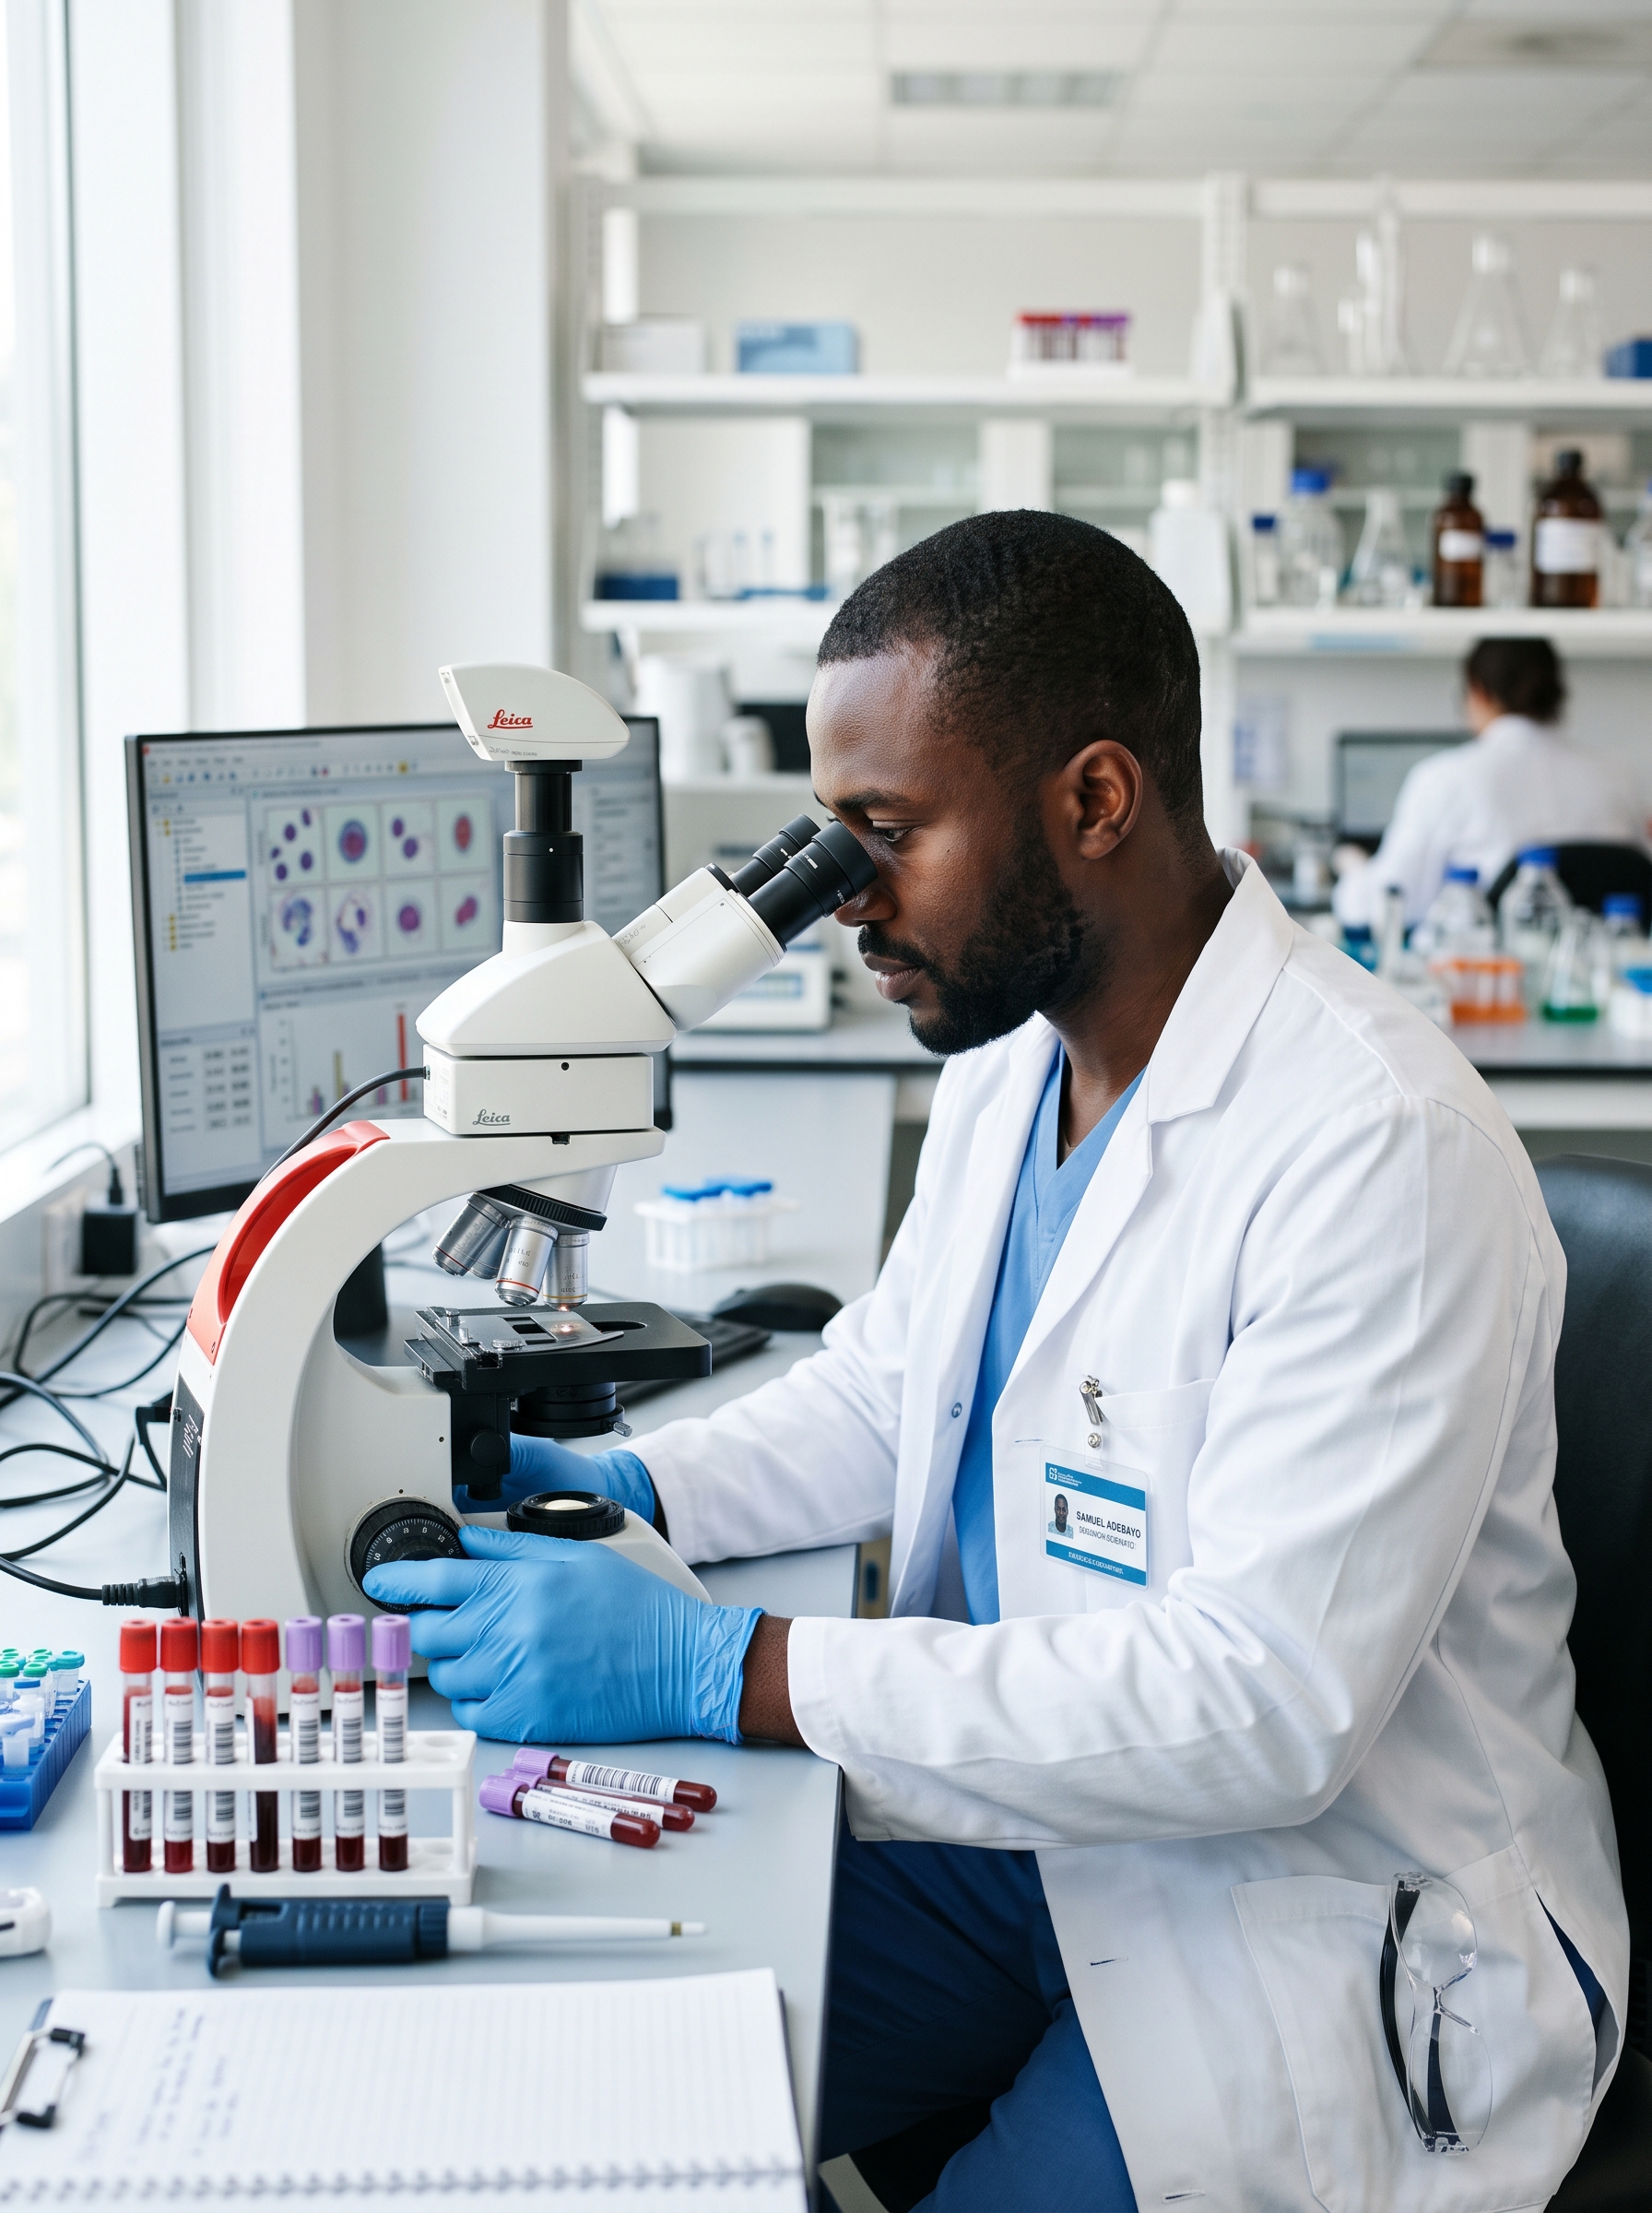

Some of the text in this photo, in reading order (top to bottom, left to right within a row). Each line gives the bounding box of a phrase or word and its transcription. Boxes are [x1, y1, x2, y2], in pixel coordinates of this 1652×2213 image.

[487, 708, 533, 729] Leica
[472, 1108, 511, 1126] Leica
[1076, 1510, 1105, 1528] SAMUEL
[1106, 1520, 1141, 1539] ADEBAYO
